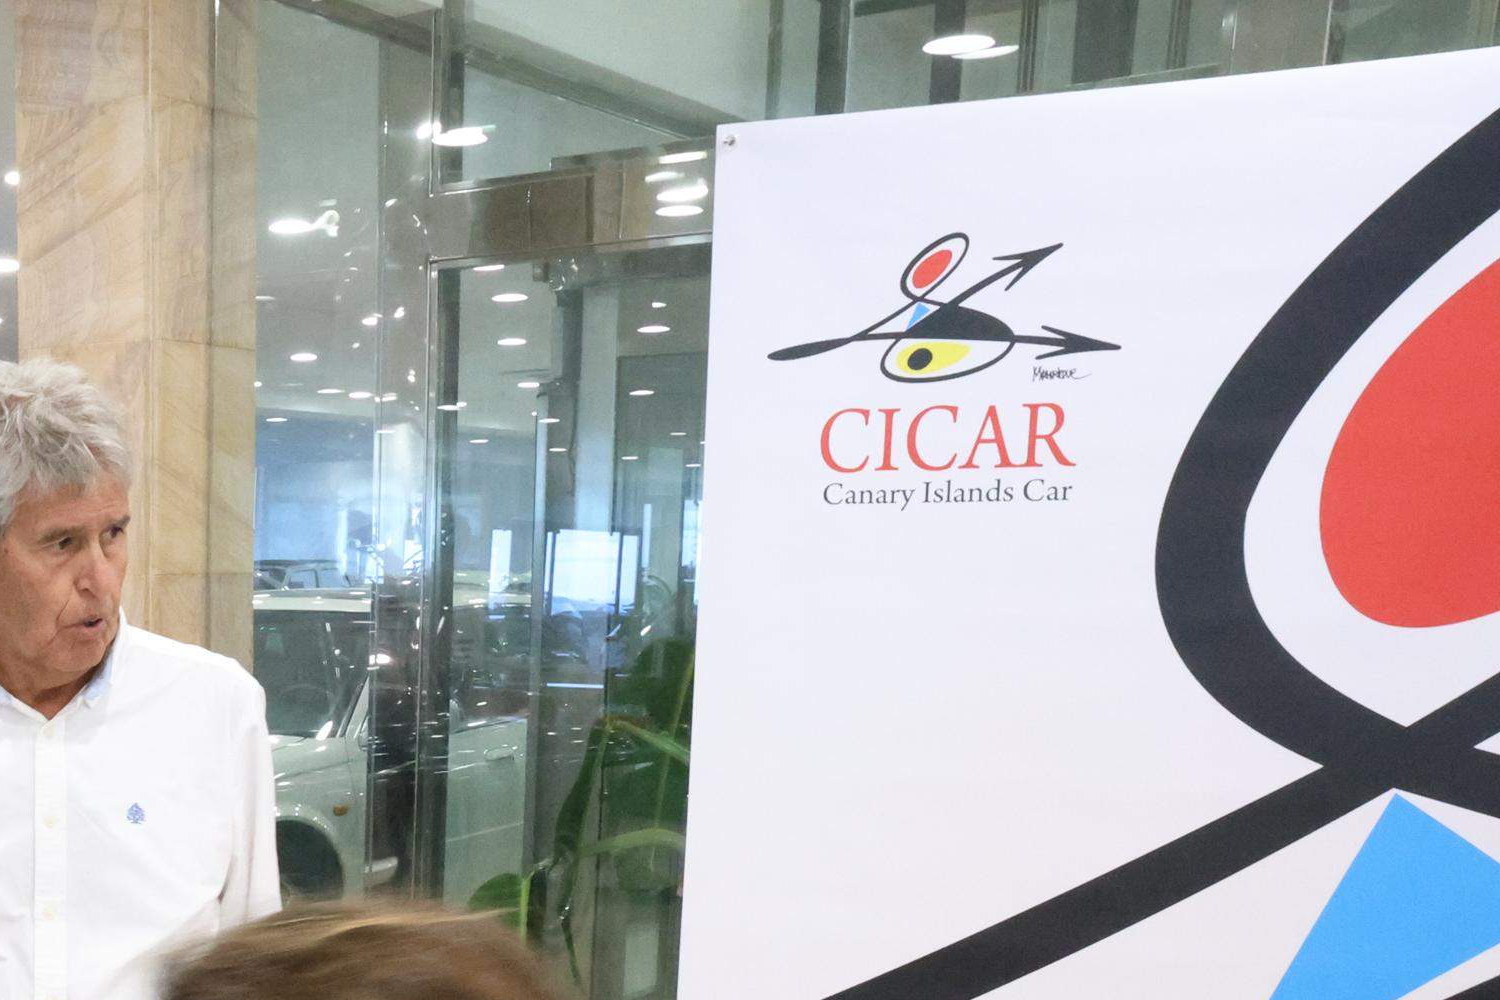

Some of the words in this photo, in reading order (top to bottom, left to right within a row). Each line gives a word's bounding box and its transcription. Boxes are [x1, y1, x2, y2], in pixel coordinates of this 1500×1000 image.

[820, 402, 1077, 474] CICAR
[823, 482, 916, 512] Canary
[923, 478, 1014, 504] Islands
[1023, 478, 1073, 502] Car
